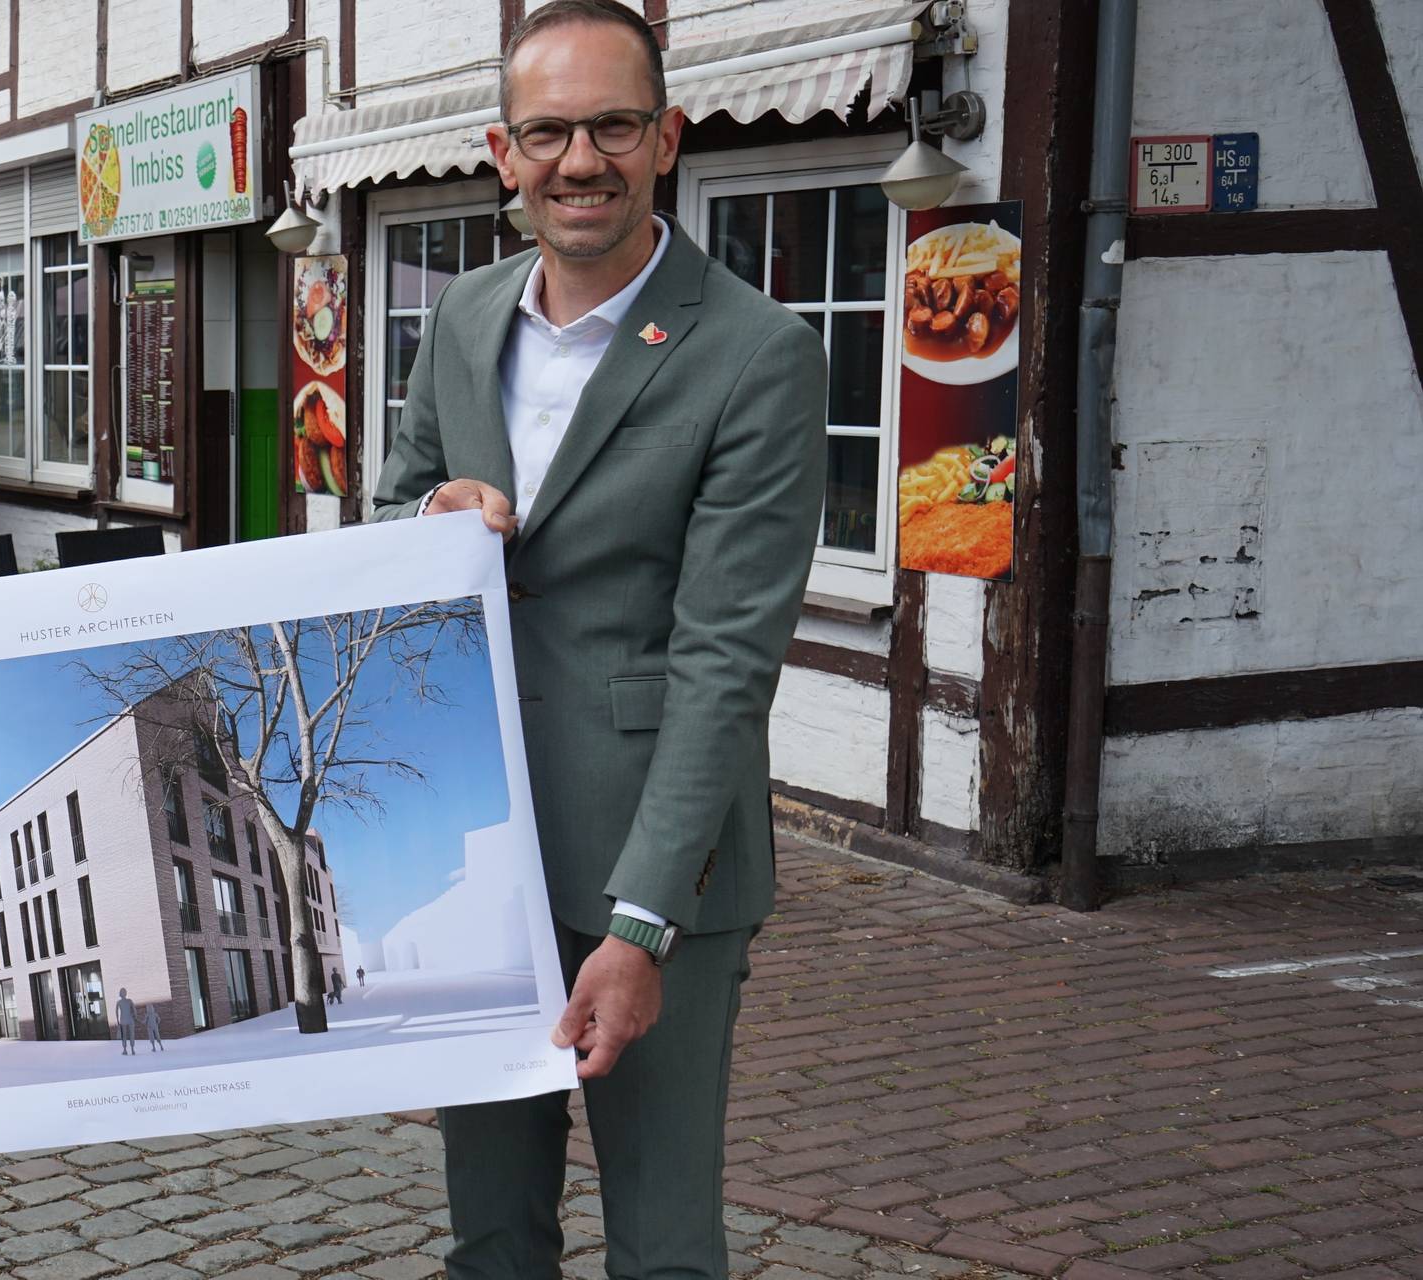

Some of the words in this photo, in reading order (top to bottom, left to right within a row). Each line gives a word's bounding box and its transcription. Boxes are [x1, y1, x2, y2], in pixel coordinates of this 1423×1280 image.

[88, 87, 235, 156] Schnellrestaurant
[131, 149, 184, 187] Imbiss
[1142, 145, 1153, 162] H
[1163, 144, 1193, 161] 300
[1216, 149, 1236, 168] HS
[1239, 155, 1251, 167] 80
[20, 625, 72, 643] HUSTER
[77, 612, 174, 635] ARCHITEKTEN
[67, 1095, 119, 1109] BEBAUUNG
[122, 1090, 165, 1104] OSTWALL
[174, 1080, 251, 1097] MÜHLENSTRASSE
